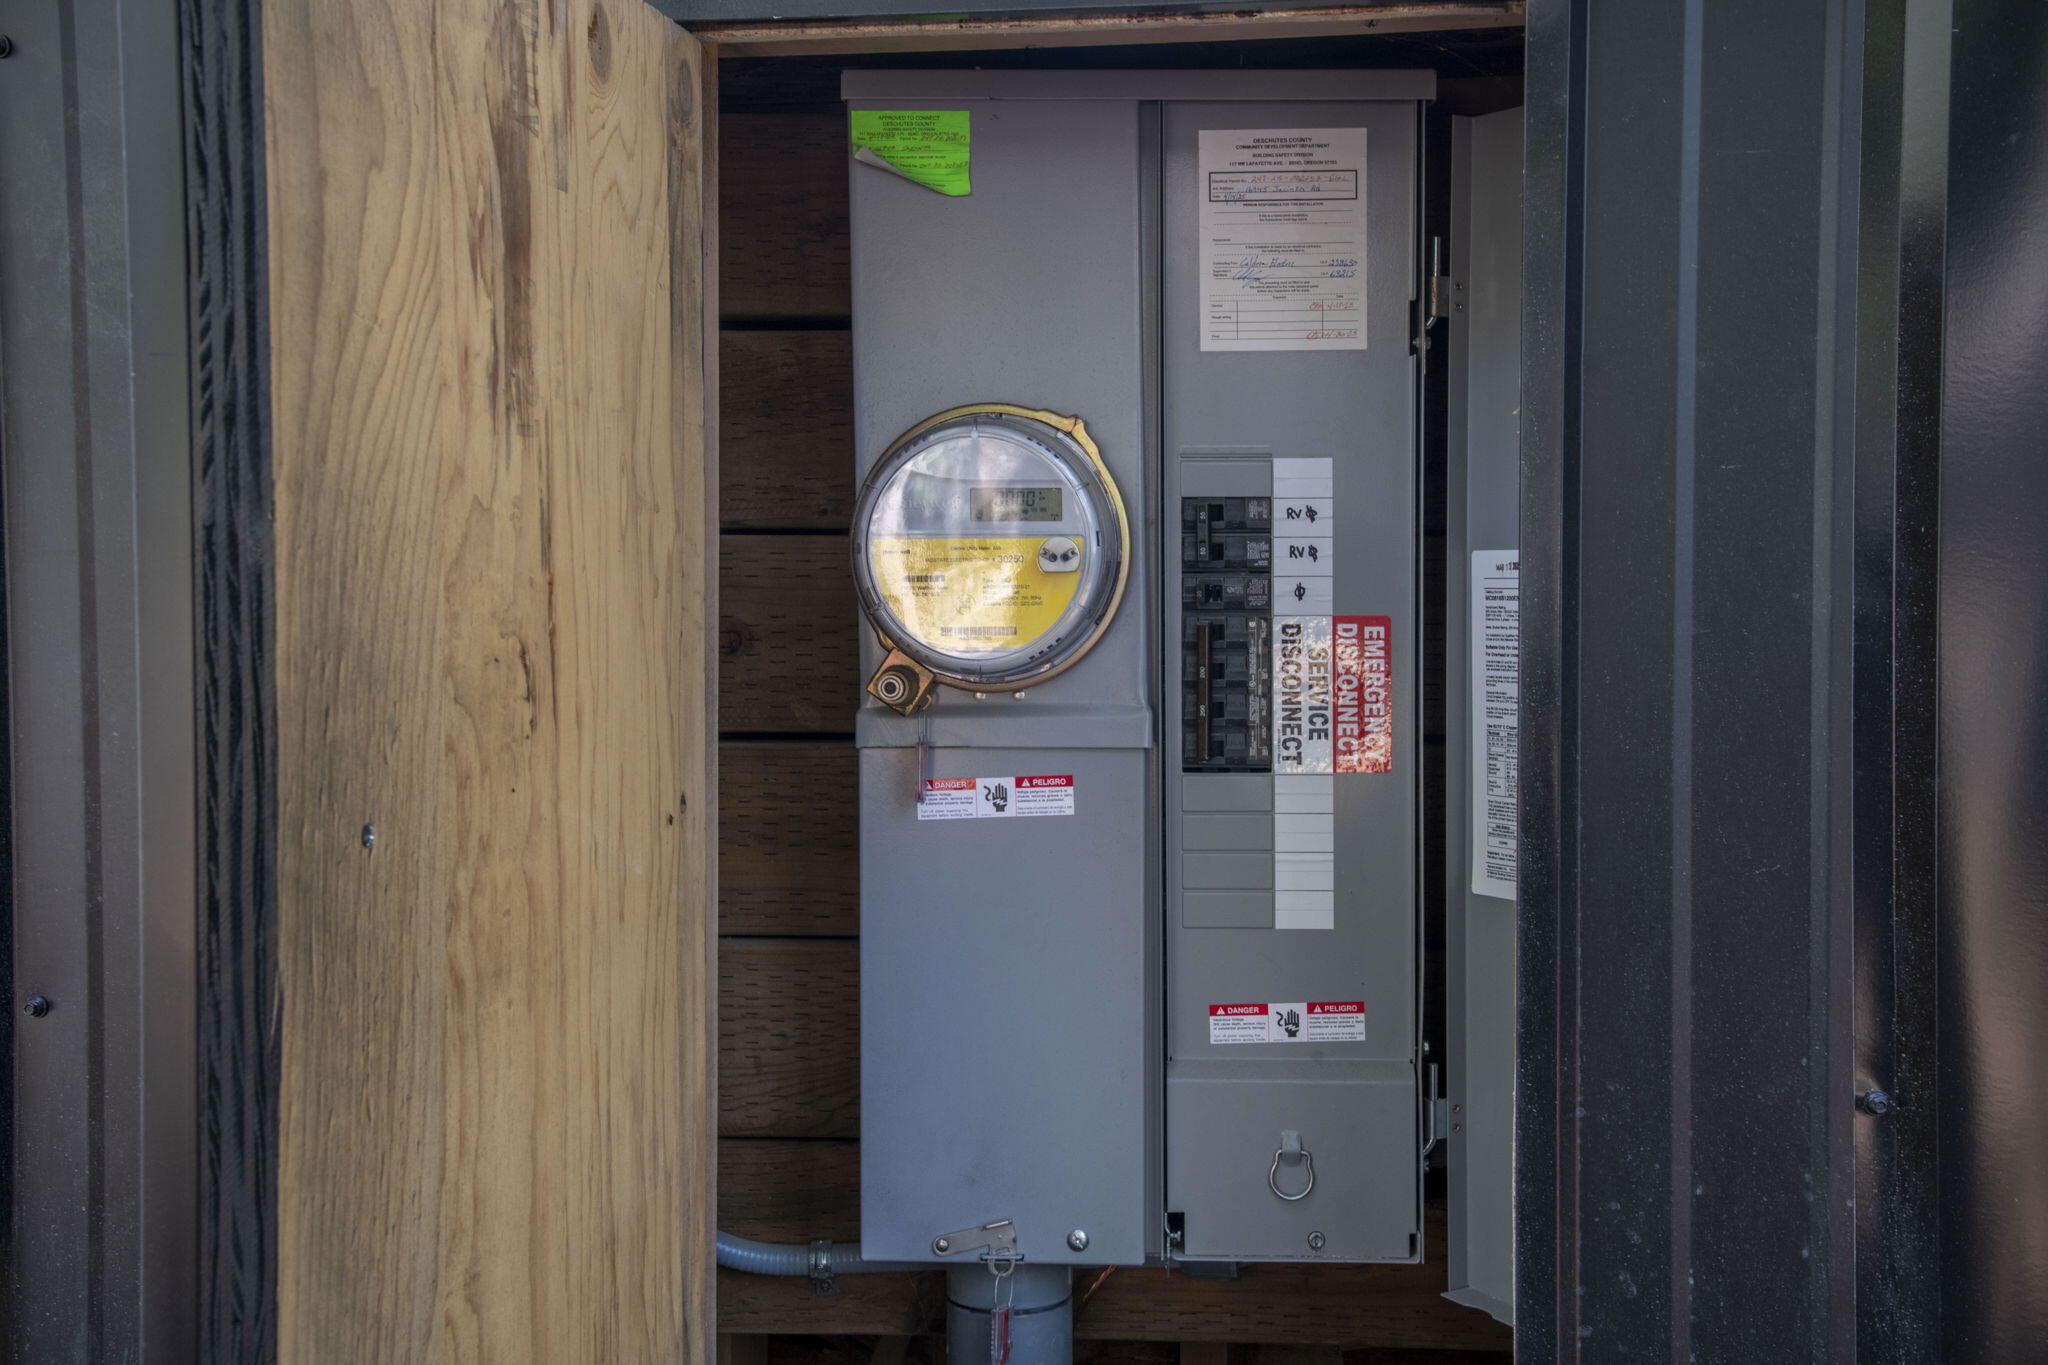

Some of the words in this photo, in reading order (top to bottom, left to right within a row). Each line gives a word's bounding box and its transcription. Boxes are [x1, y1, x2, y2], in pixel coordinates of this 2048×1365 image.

[1287, 507, 1301, 520] RV
[1290, 546, 1304, 559] RV
[1281, 622, 1302, 766] DISCONNECT
[1308, 647, 1328, 741] SERVICE
[1336, 622, 1358, 764] DISCONNECT
[1364, 625, 1385, 763] EMERGENCY
